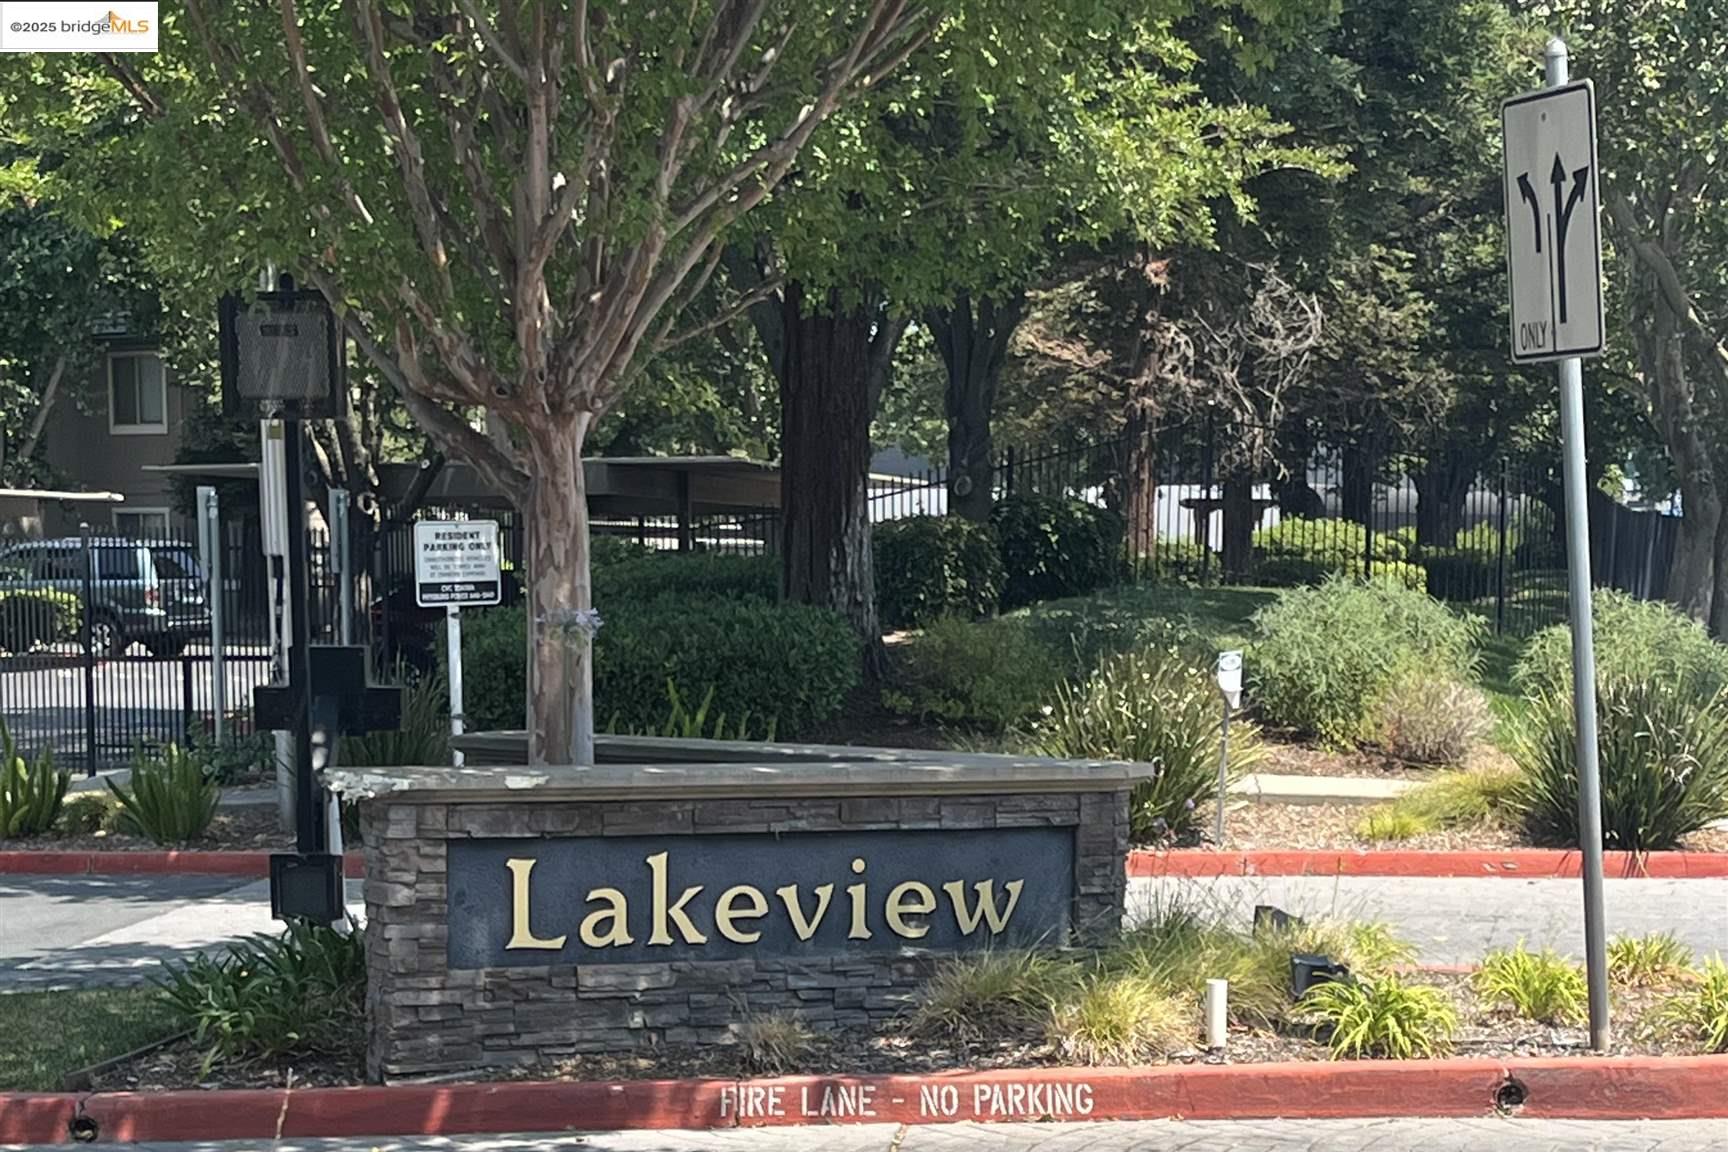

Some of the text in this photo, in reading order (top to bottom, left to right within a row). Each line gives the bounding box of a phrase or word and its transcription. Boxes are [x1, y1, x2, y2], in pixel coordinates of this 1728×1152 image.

[1520, 320, 1547, 350] ONLY
[423, 542, 492, 551] PARKING ONLY
[435, 532, 480, 540] RESIDENT
[505, 851, 1024, 950] Lakeview
[720, 1086, 785, 1118] FIRE
[801, 1086, 877, 1116] LANE
[920, 1084, 959, 1115] NO
[974, 1083, 1094, 1115] PARKING
